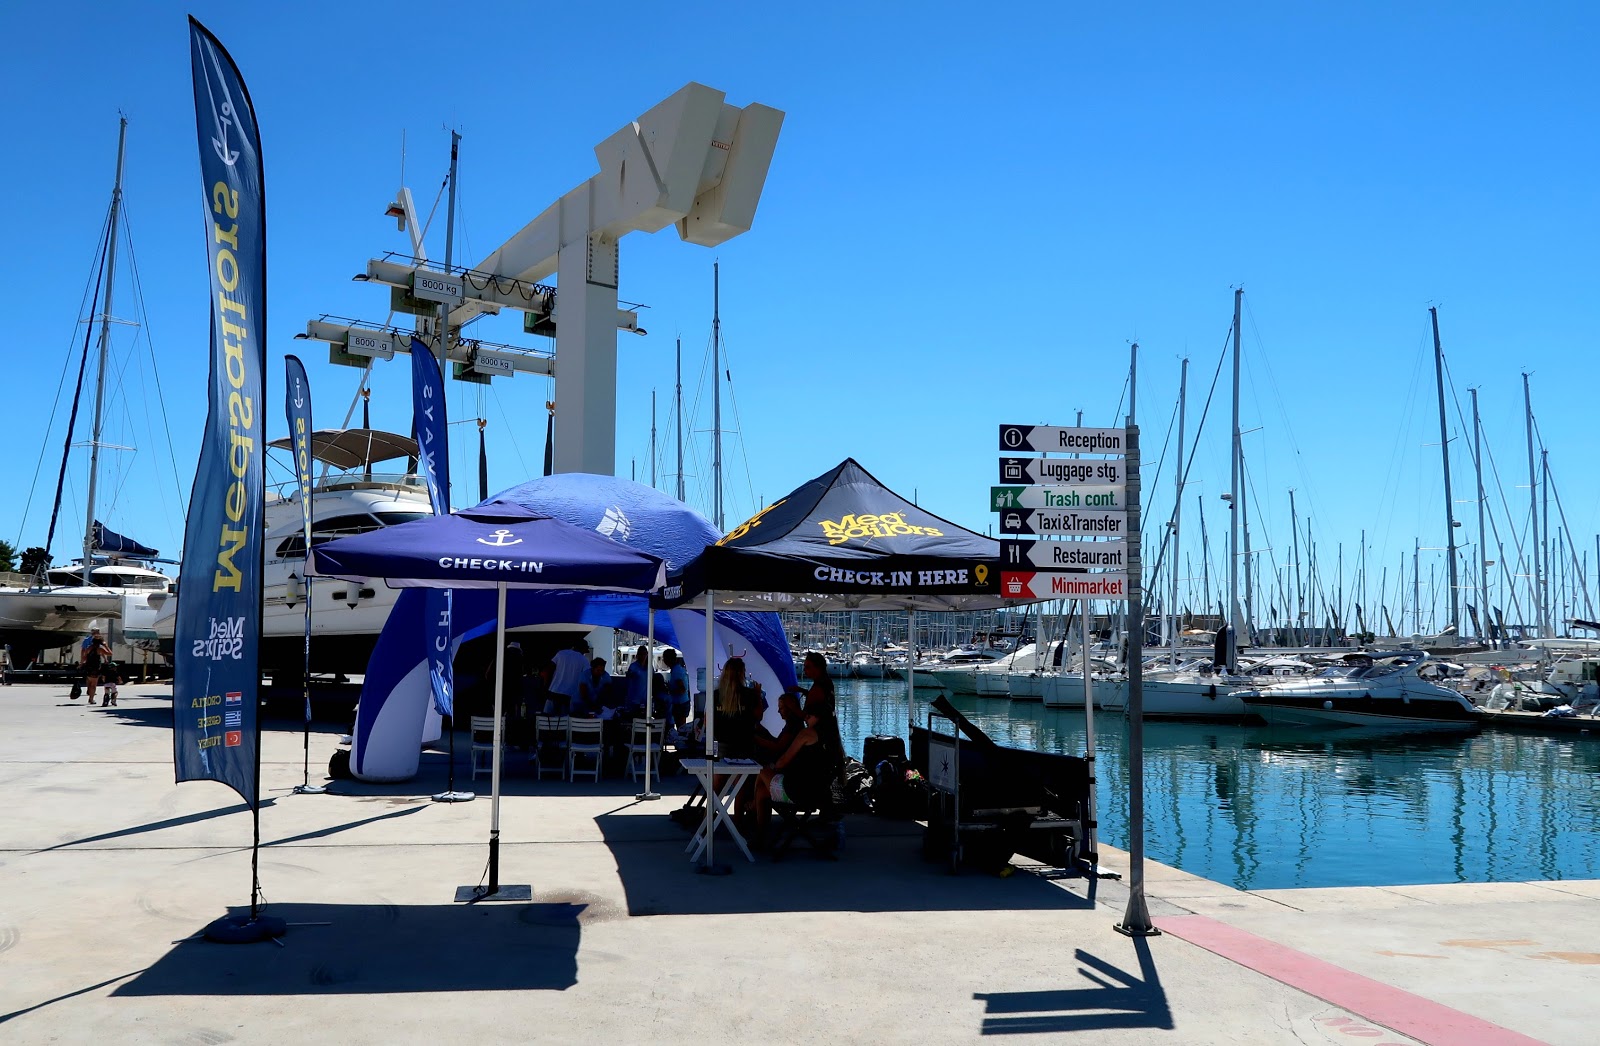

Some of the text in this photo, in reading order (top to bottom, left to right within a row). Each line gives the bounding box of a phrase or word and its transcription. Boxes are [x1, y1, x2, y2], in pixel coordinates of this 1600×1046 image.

[422, 280, 457, 295] 8000 kg
[355, 338, 375, 348] 8000
[480, 357, 509, 370] 8000 kg
[1059, 430, 1120, 452] Reception
[1040, 460, 1120, 482] Luggage stg.
[1043, 490, 1118, 506] Trash cont.
[818, 512, 907, 533] Med
[1036, 513, 1122, 532] Taxi&Transfer
[825, 523, 944, 545] Sailors
[1053, 546, 1122, 565] Restaurant
[438, 557, 544, 574] CHECK-IN
[813, 566, 969, 587] CHECK-IN HERE
[1052, 576, 1123, 595] Minimarket
